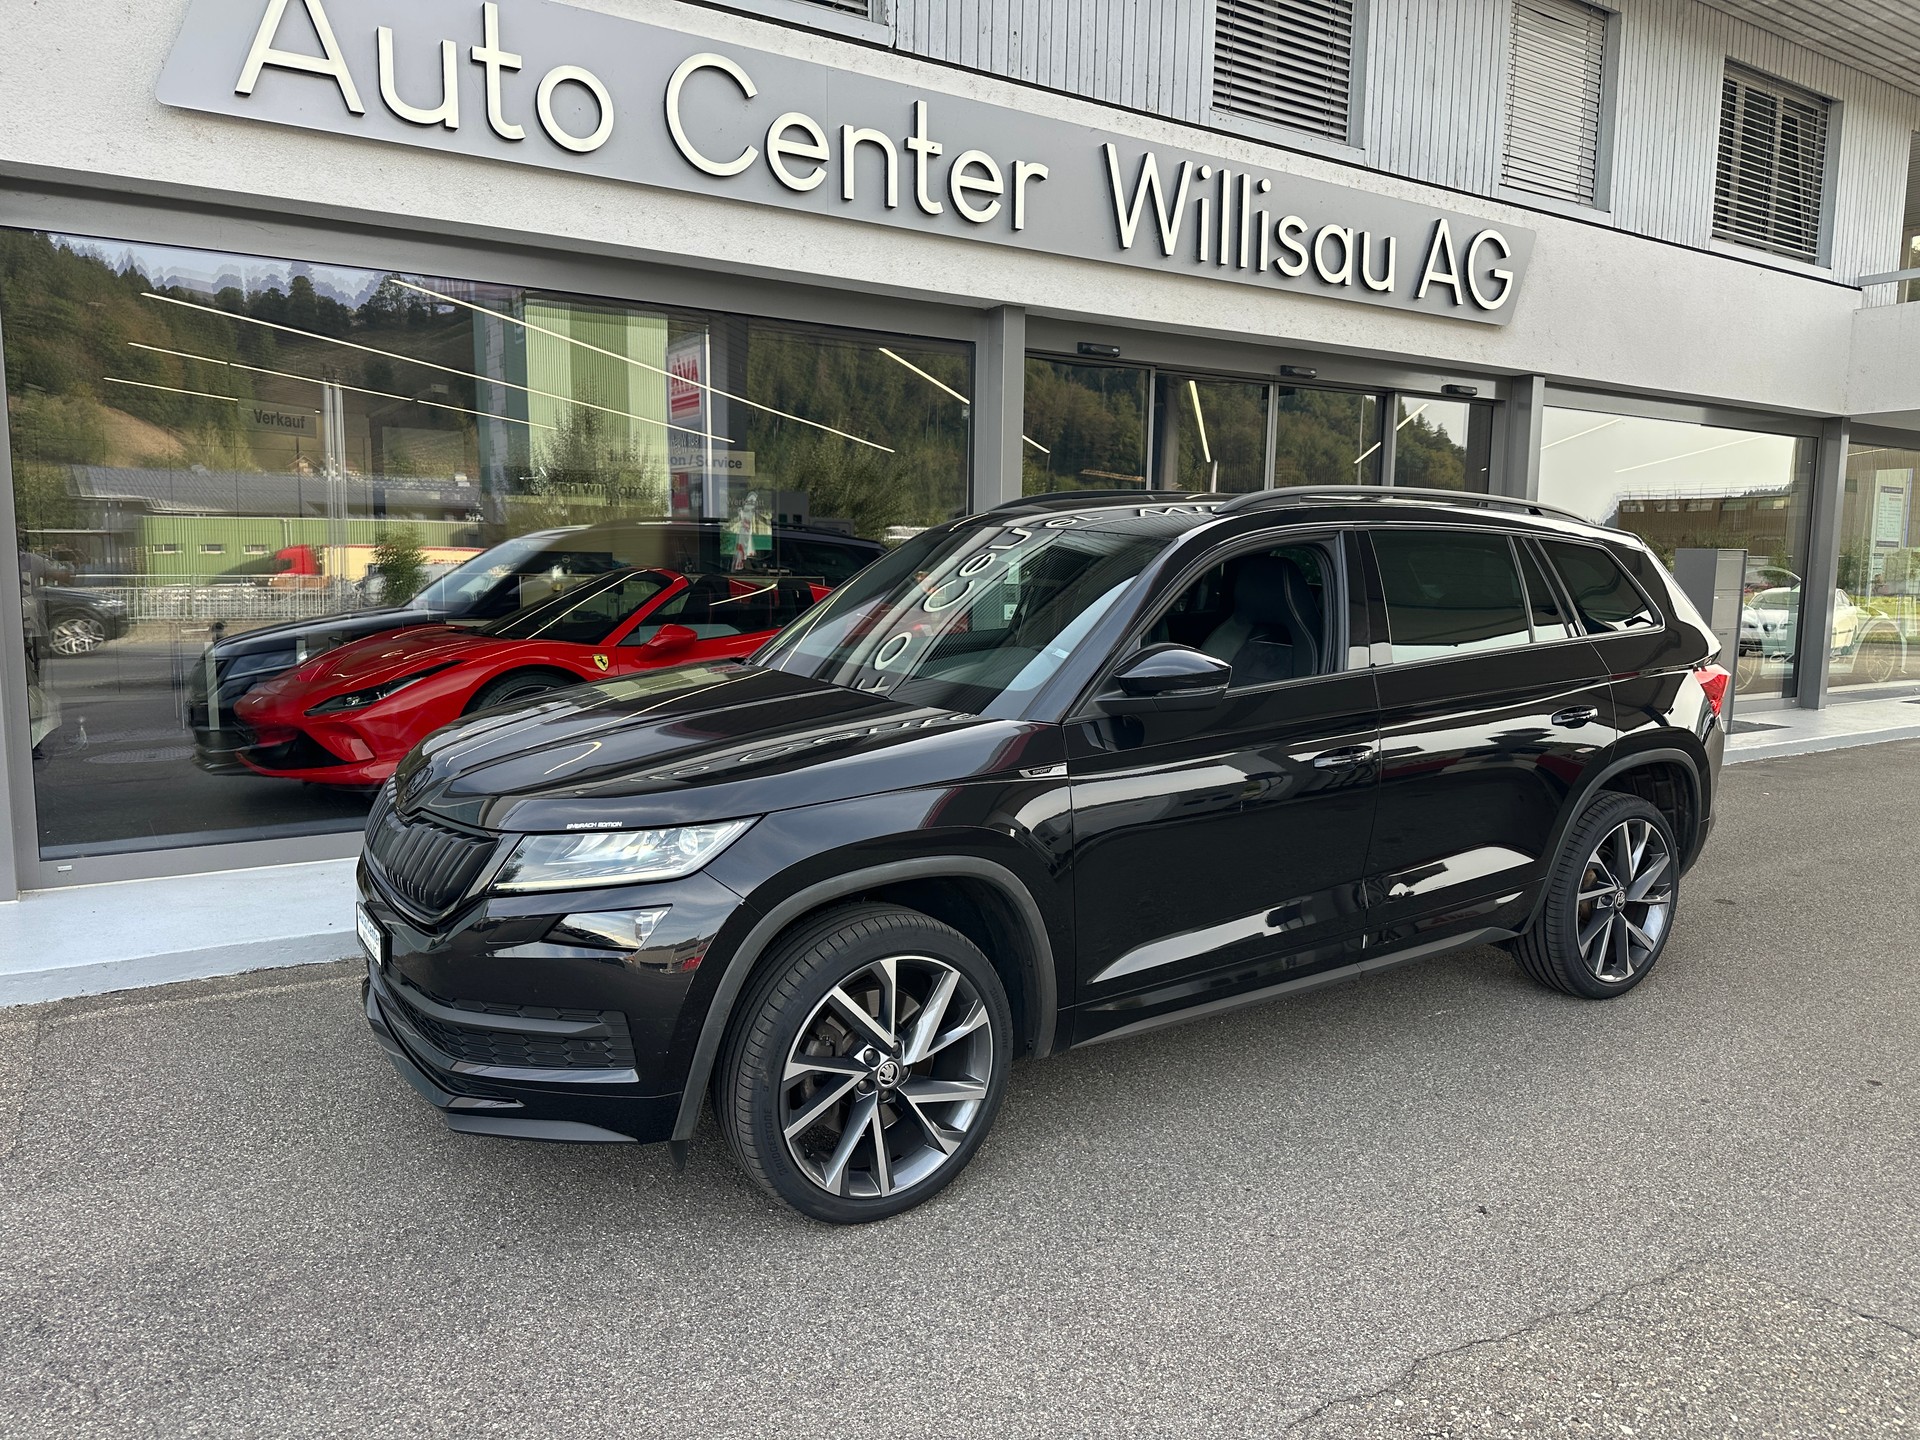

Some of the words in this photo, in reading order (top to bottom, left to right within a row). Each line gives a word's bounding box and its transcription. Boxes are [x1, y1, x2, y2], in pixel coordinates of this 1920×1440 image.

[234, 0, 614, 153] Auto
[663, 52, 1049, 230] Center
[1102, 142, 1397, 293] Willisau
[1415, 217, 1514, 311] AG
[253, 408, 306, 429] Verkauf
